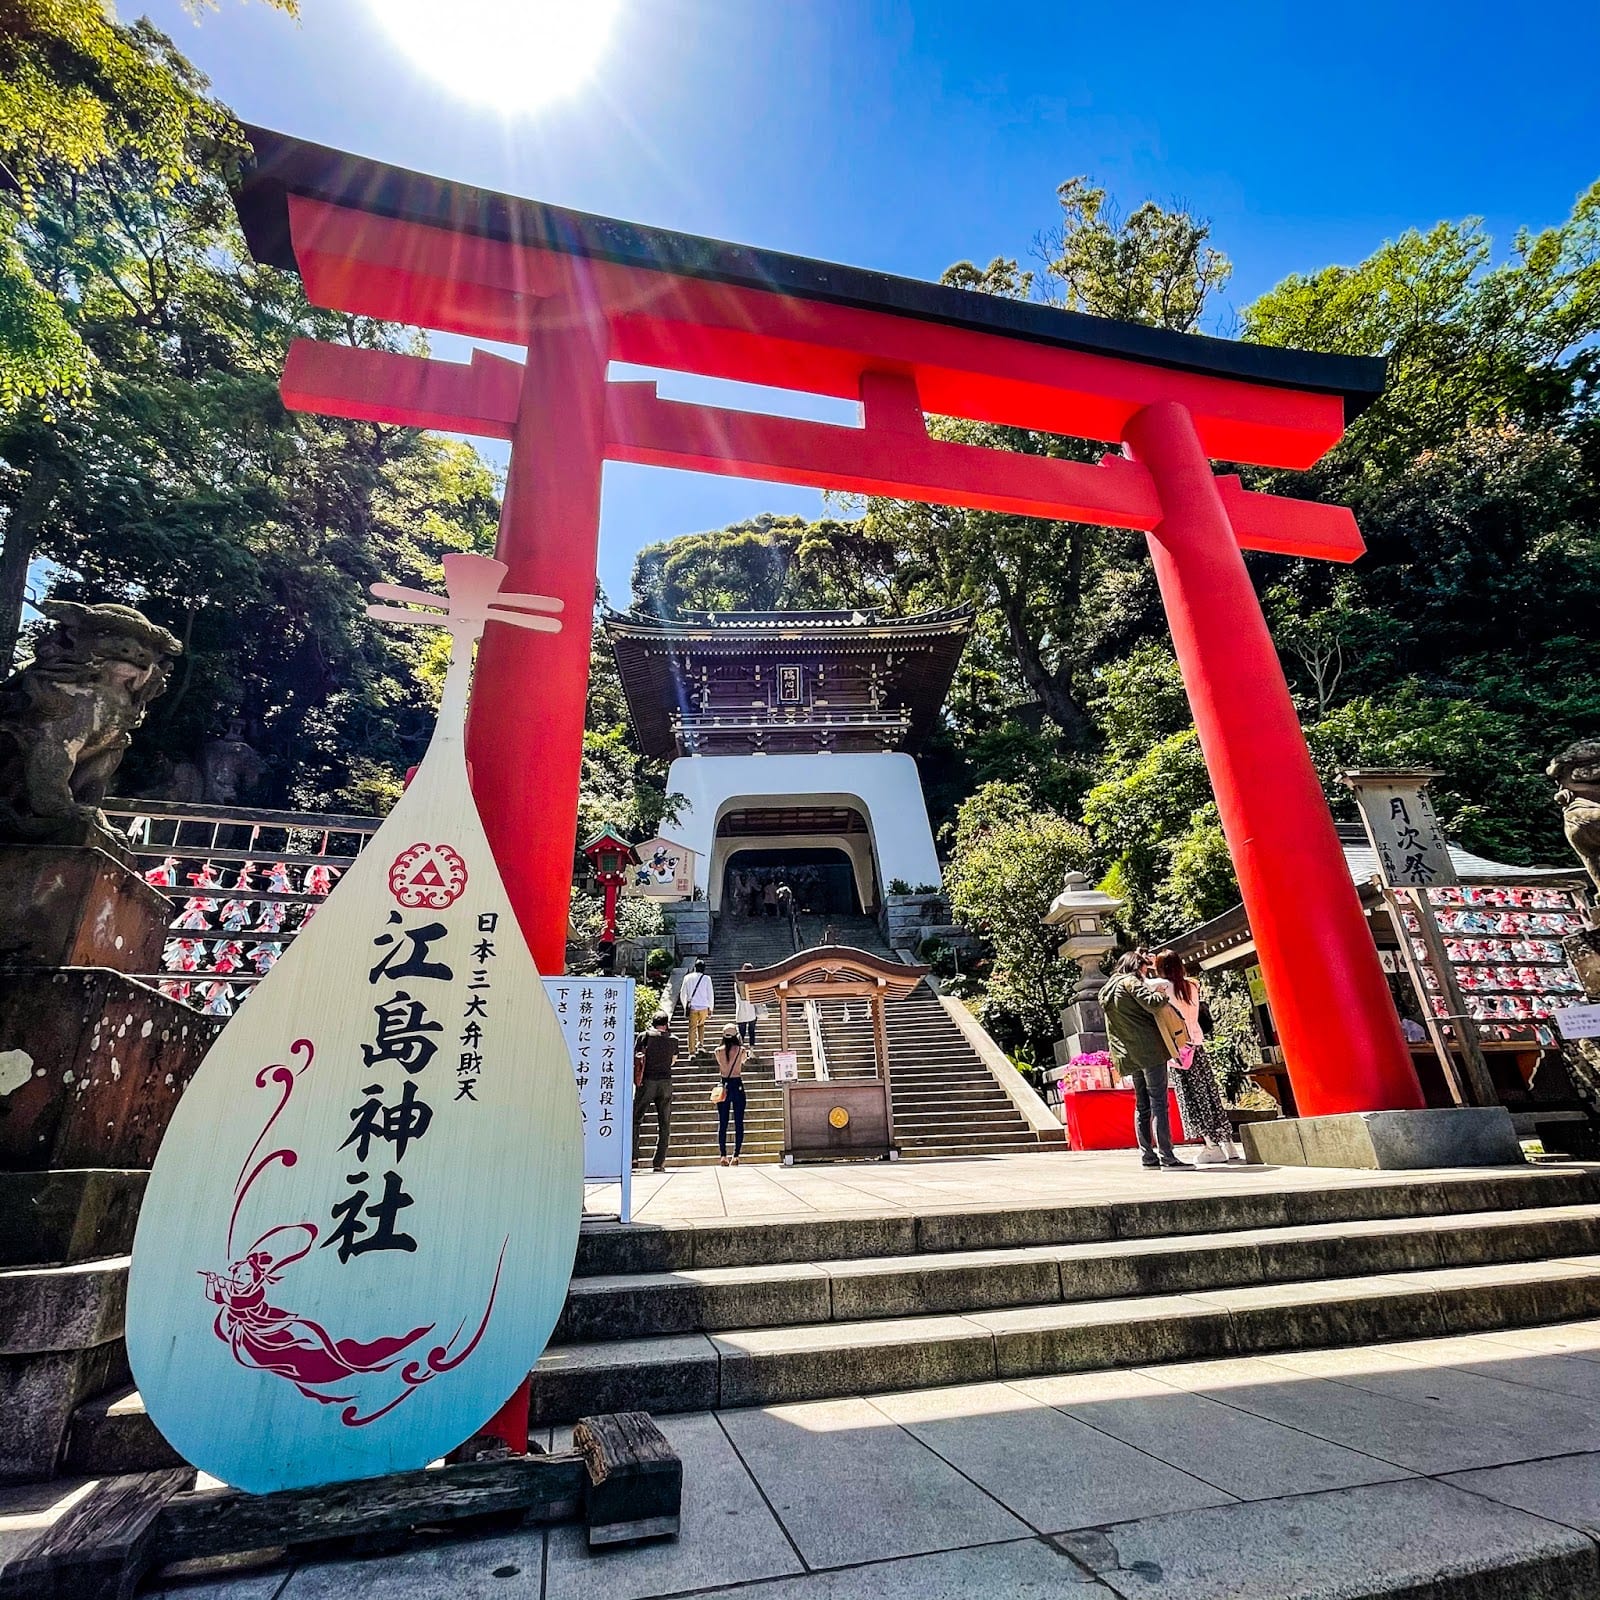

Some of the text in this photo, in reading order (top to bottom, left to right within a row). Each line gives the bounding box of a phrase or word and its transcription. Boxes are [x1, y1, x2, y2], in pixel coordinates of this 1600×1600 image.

[1389, 797, 1438, 885] 月次祭
[319, 910, 455, 1265] 江島神社
[453, 913, 499, 1102] 日本三大弁財天
[599, 987, 618, 1138] 御祈祷の方は階段上の
